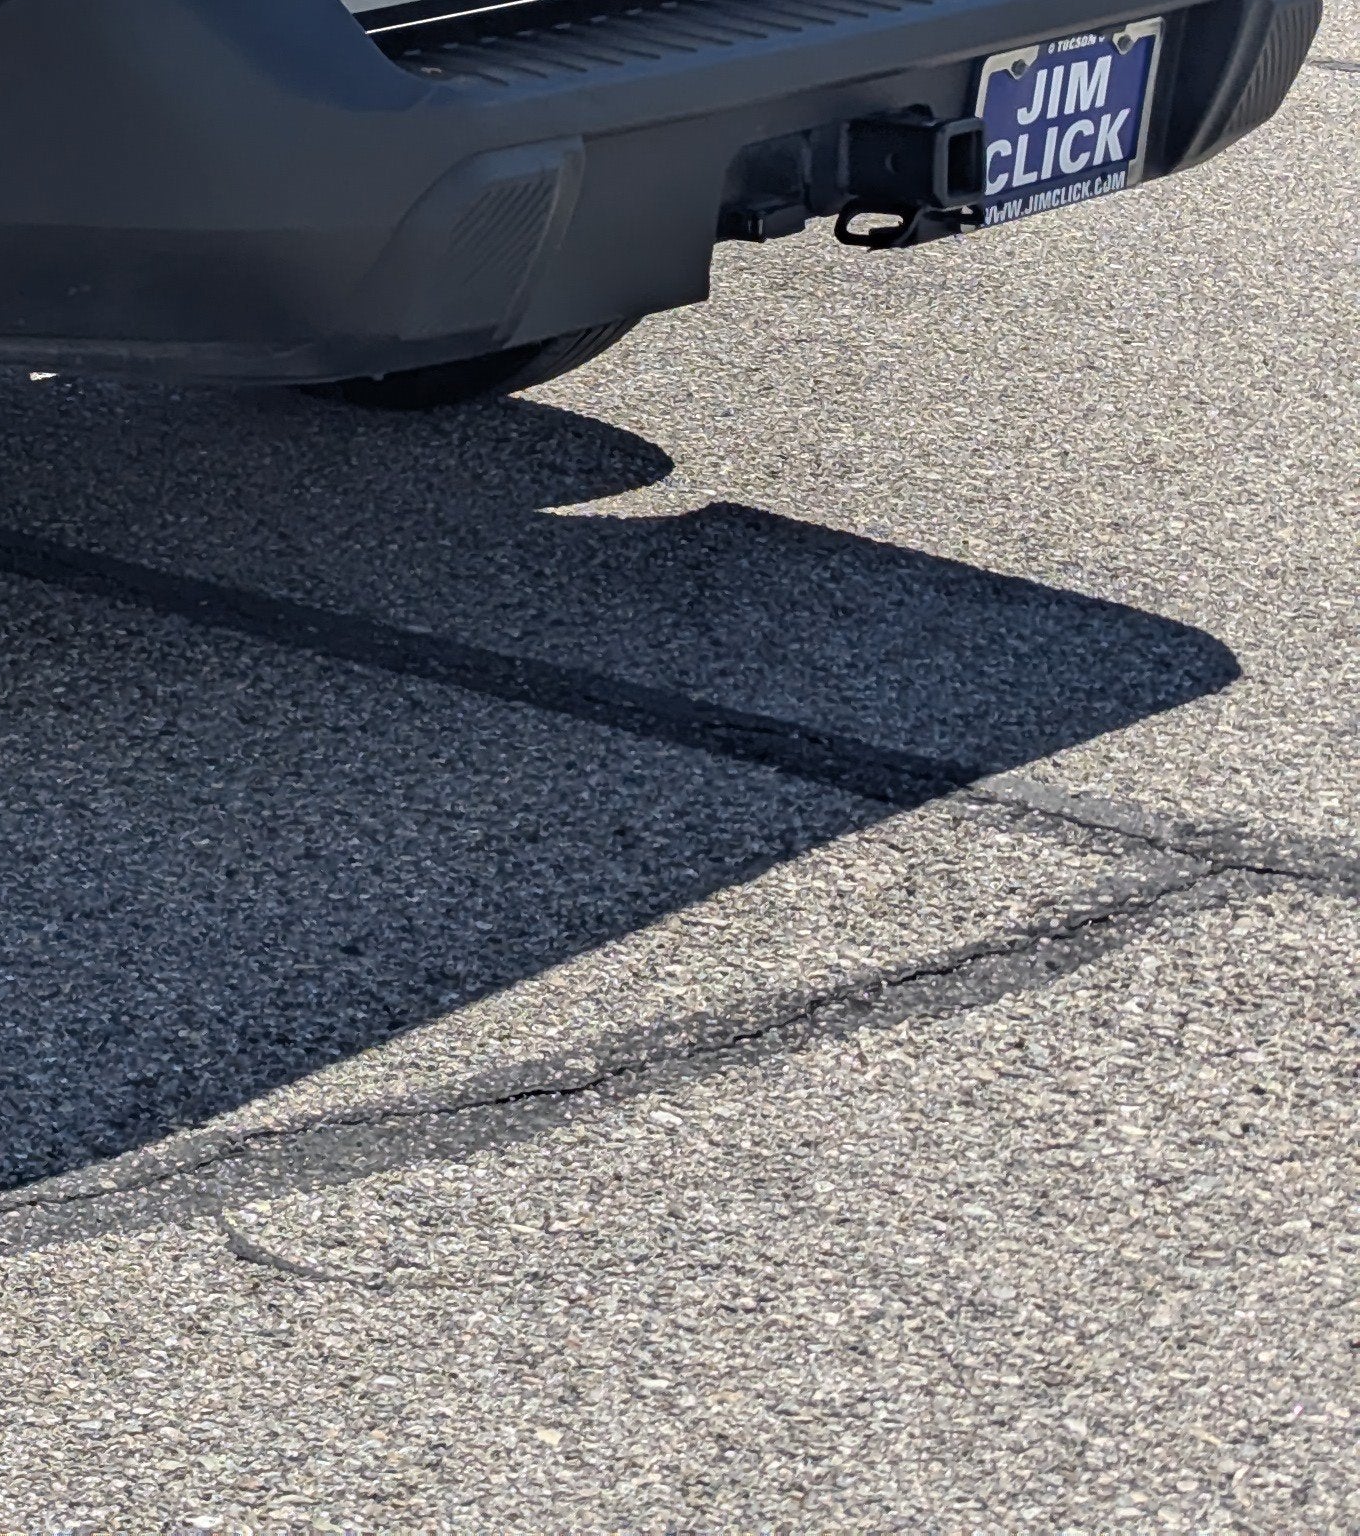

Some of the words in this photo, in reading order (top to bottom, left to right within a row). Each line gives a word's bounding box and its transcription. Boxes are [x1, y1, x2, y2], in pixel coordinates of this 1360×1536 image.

[1057, 34, 1097, 52] TUCSON
[1016, 54, 1113, 126] JIM
[984, 108, 1130, 196] CLICK
